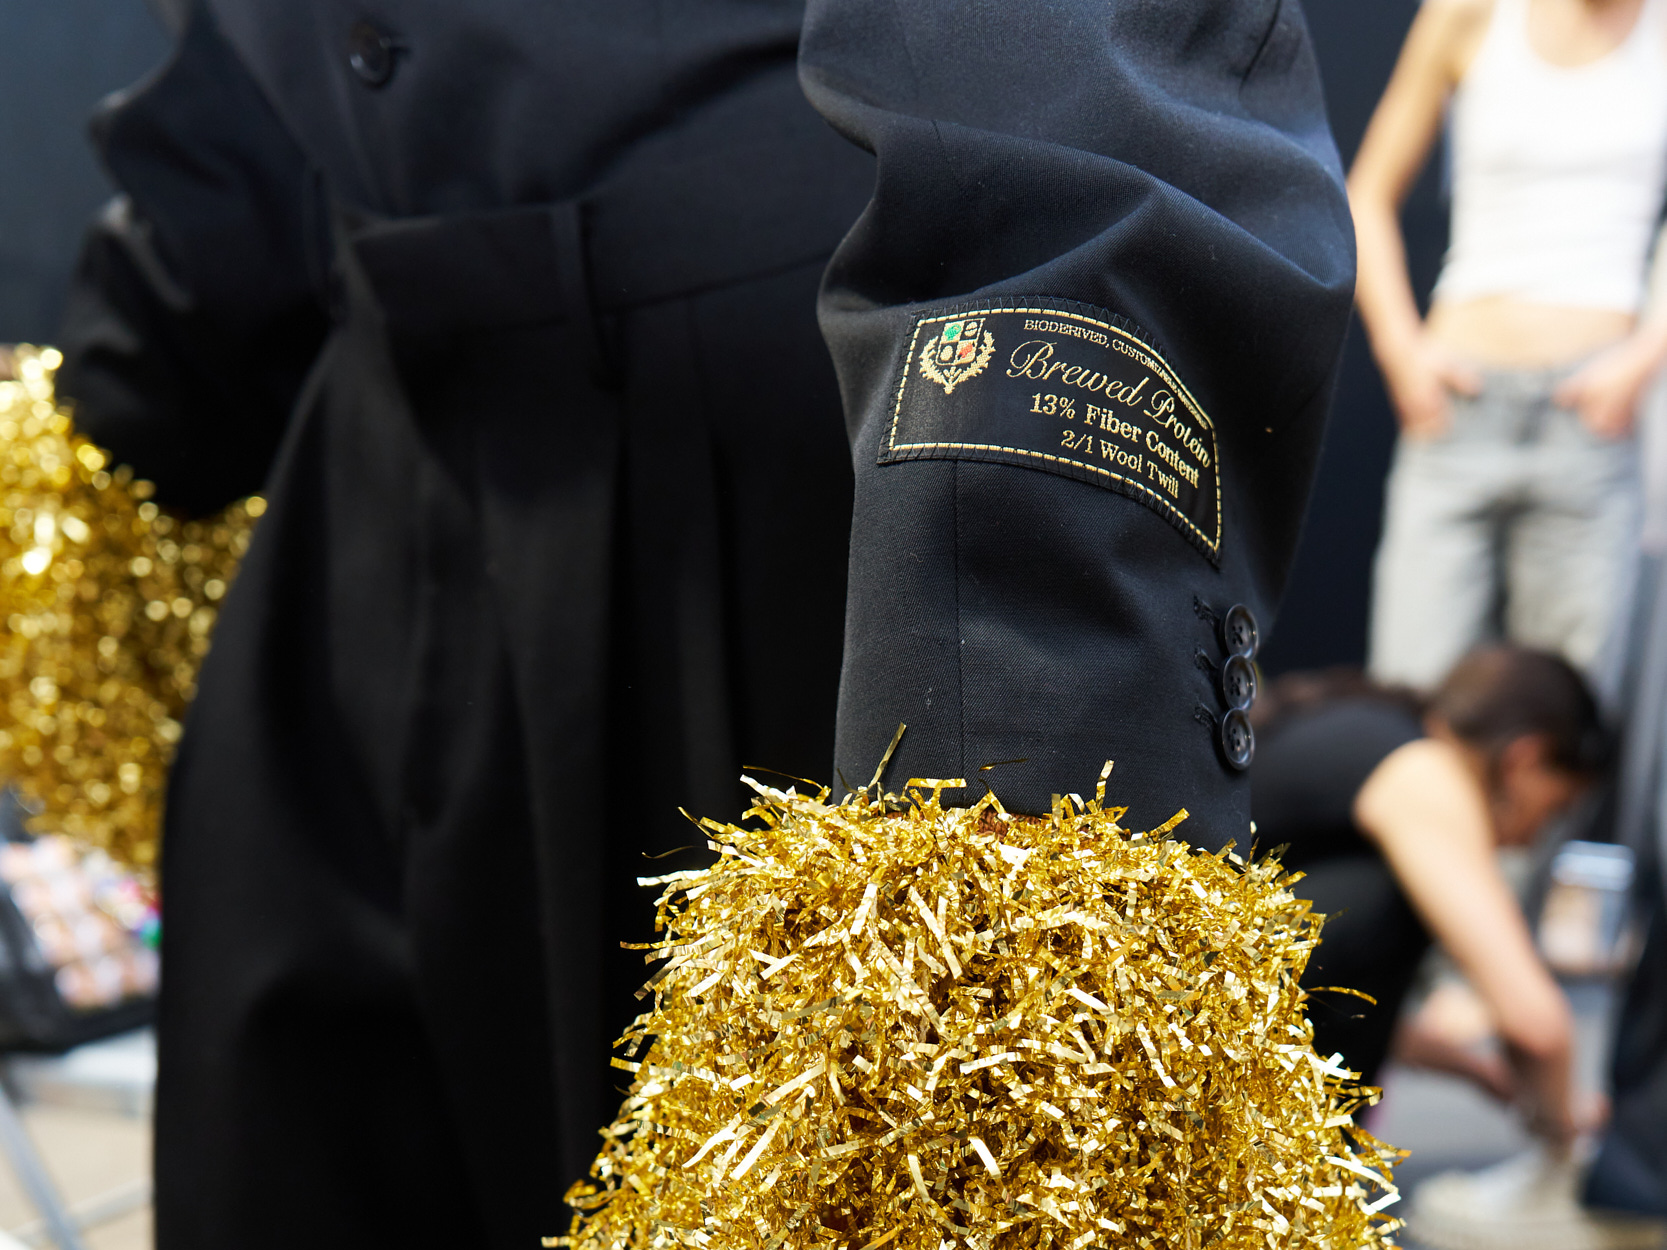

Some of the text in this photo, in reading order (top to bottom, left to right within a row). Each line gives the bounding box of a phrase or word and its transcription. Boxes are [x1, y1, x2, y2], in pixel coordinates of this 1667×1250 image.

[1024, 319, 1110, 349] BIODERIVED,
[1005, 340, 1150, 406] Brewed
[1143, 389, 1211, 468] Protein
[1029, 392, 1076, 419] 13%
[1084, 403, 1142, 443] Fiber
[1145, 430, 1199, 489] Content
[1060, 429, 1179, 499] 2/1 Wool Twill
